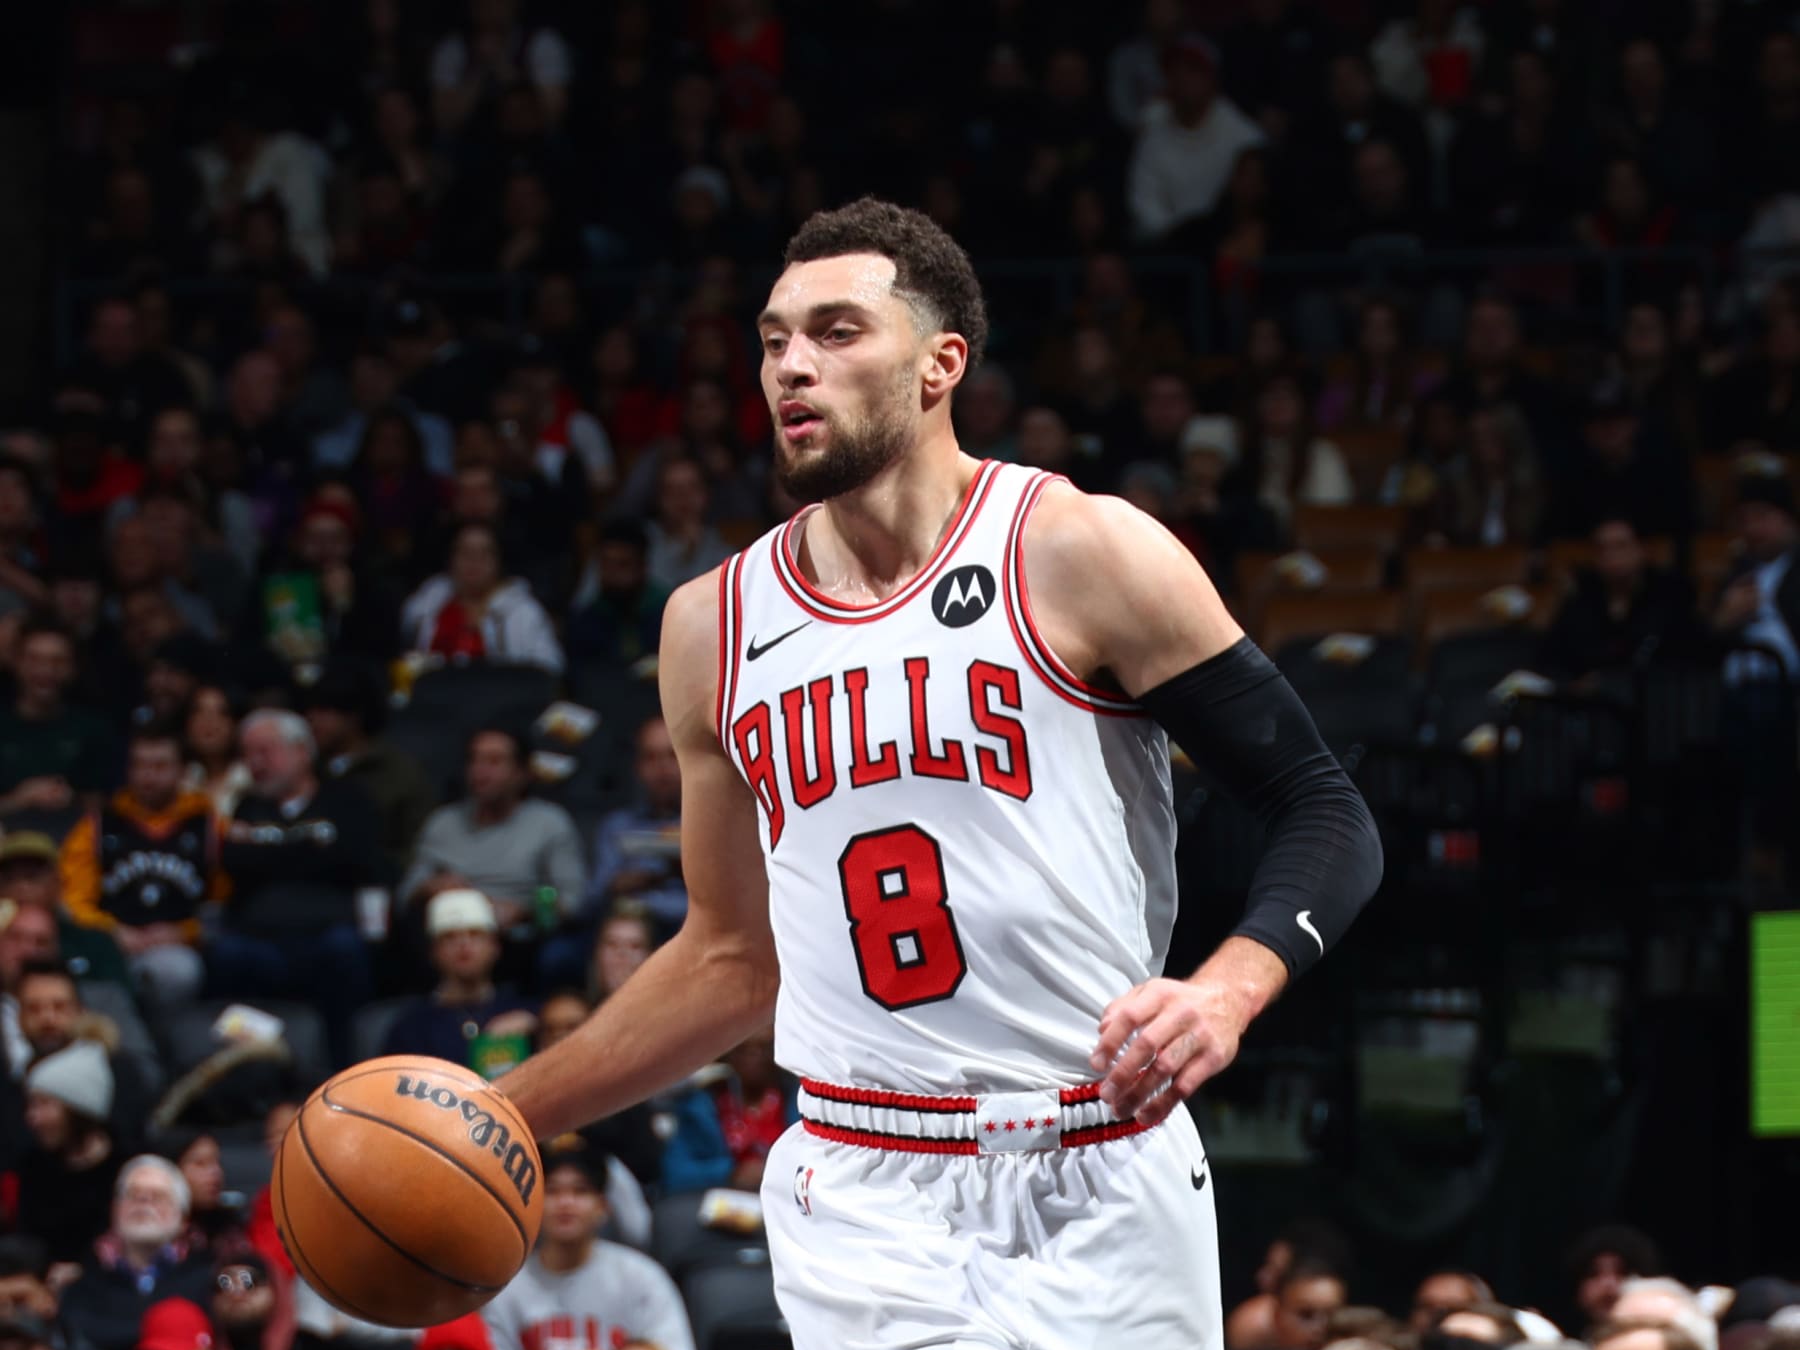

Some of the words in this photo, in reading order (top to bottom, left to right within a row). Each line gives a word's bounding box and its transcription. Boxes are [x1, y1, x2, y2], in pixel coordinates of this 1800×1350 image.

[732, 656, 1033, 854] BULLS
[837, 822, 968, 1012] 8
[395, 1075, 537, 1208] Wilson
